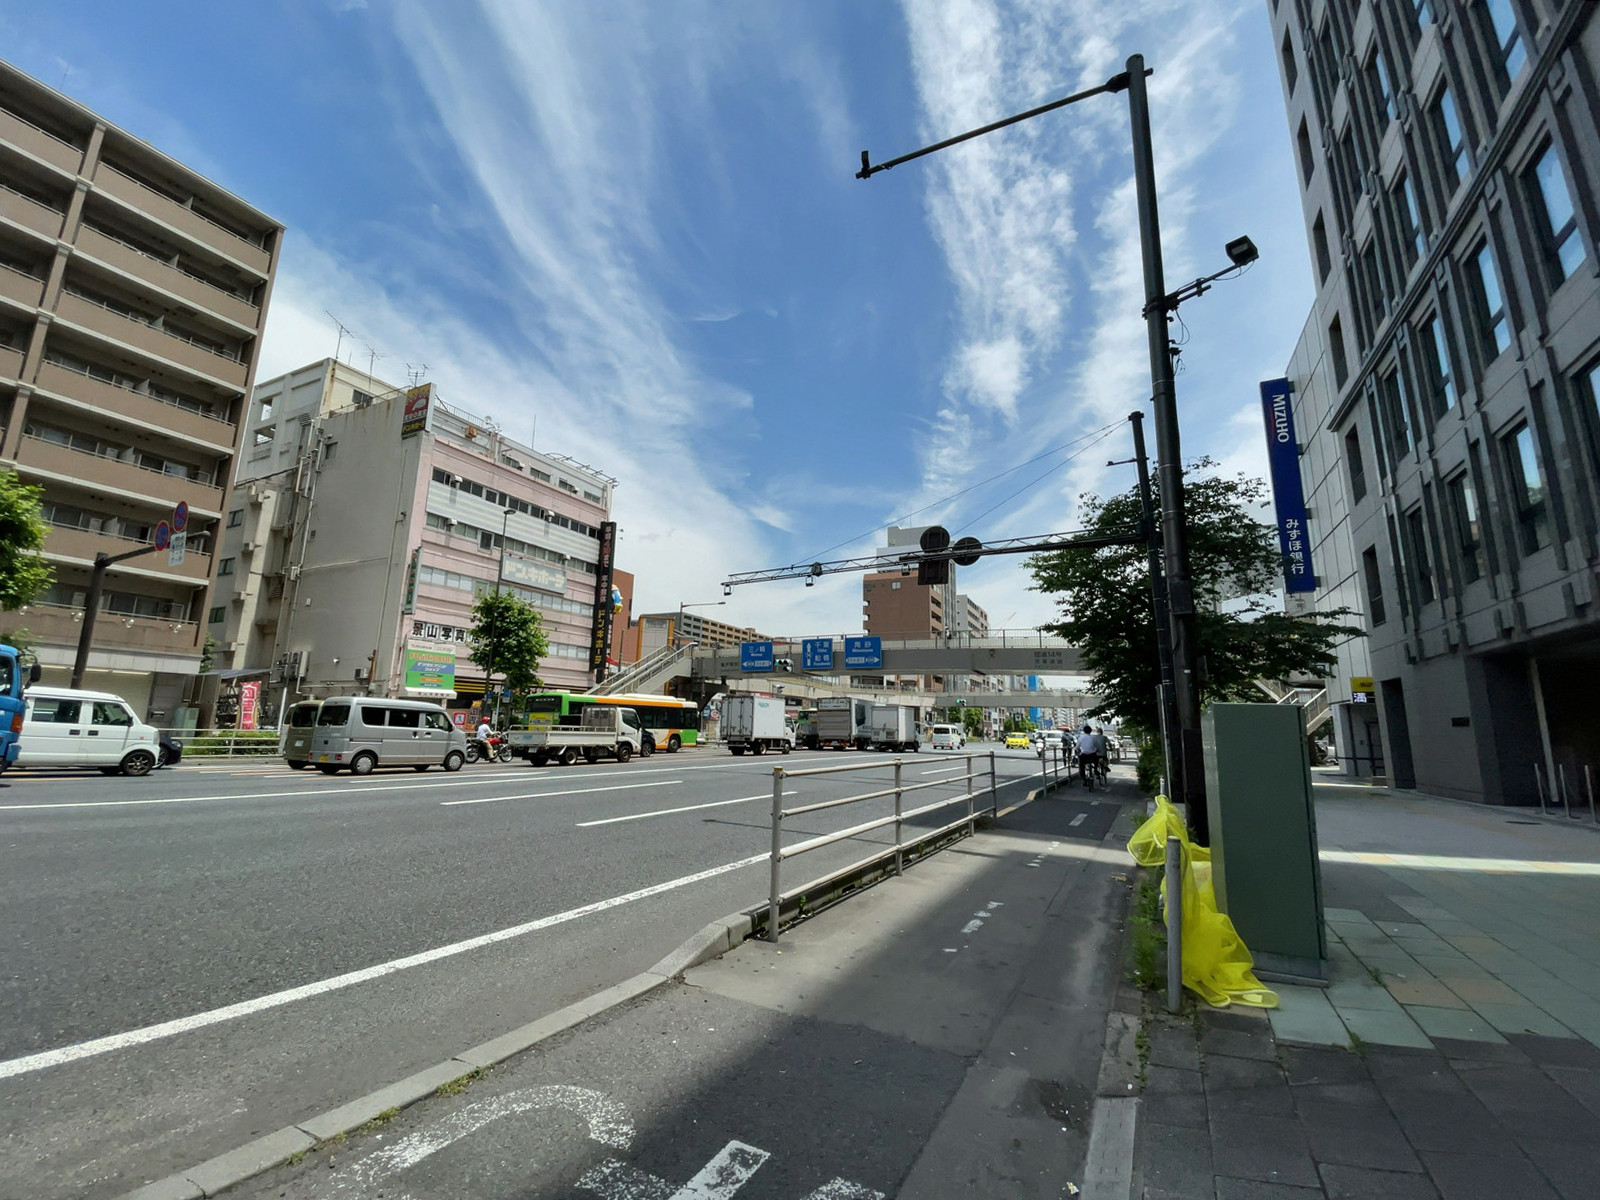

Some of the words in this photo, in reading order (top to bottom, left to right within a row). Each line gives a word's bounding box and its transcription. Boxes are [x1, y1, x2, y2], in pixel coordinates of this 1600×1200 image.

[1272, 394, 1290, 443] MIZUHO
[1286, 519, 1304, 575] みずほ銀行
